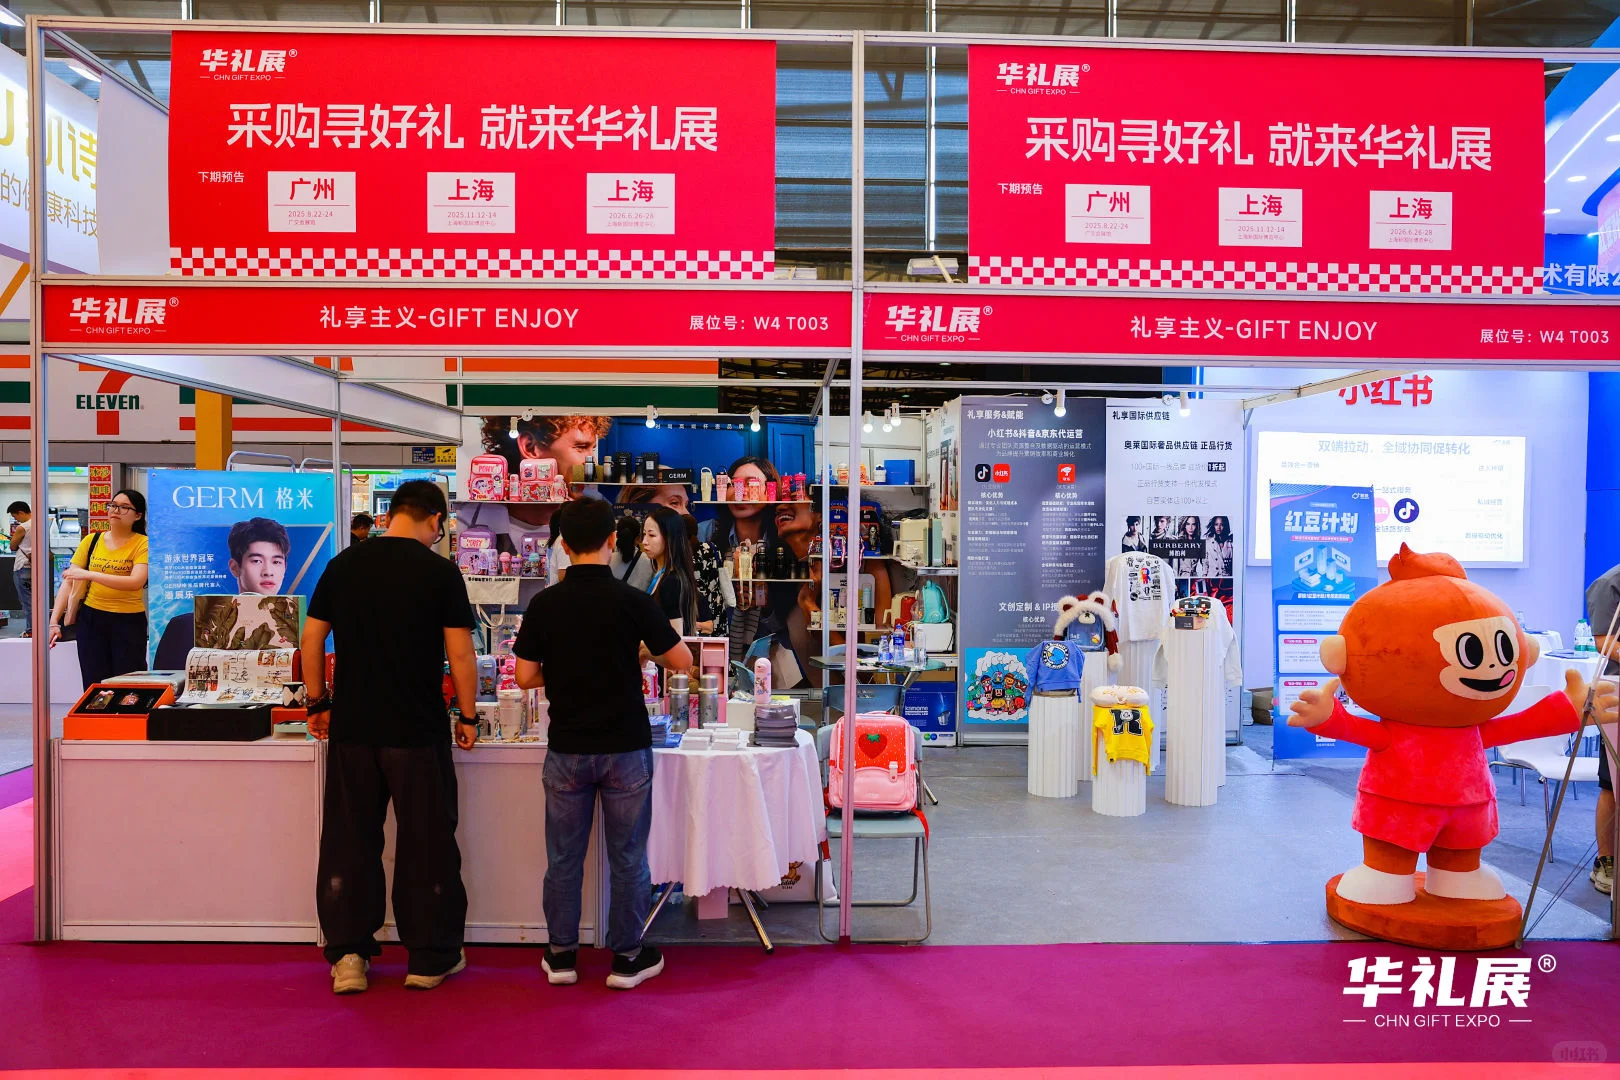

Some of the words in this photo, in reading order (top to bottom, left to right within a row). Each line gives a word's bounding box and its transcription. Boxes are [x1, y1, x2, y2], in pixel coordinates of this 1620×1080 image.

[200, 49, 286, 72] 华礼展
[997, 62, 1080, 87] 华礼展
[227, 102, 465, 149] 采购寻好礼
[480, 104, 718, 152] 就来华礼展
[1025, 117, 1254, 165] 采购寻好礼
[1268, 121, 1492, 171] 就来华礼展
[198, 171, 245, 183] 下期预告
[289, 177, 335, 200] 广州
[447, 178, 495, 202] 上海
[607, 179, 655, 202] 上海
[997, 183, 1043, 195] 下期预告
[0, 168, 98, 238] 的康科技
[1086, 190, 1130, 213] 广州
[1238, 194, 1283, 217] 上海
[1389, 197, 1433, 220] 上海
[447, 211, 497, 219] 2025.11.12-14
[1085, 222, 1129, 230] 2025.8.22-24
[1237, 225, 1285, 233] 2025.11.12-14
[1389, 228, 1433, 236] 2026.6.26-28
[69, 296, 167, 325] 华礼展
[319, 305, 486, 329] 礼享主义-GIFT
[495, 307, 579, 329] ENJOY
[885, 305, 981, 333] 华礼展
[86, 326, 105, 334] CHN
[106, 327, 125, 335] GIFT
[127, 327, 151, 335] EXPO
[753, 316, 780, 330] W4
[786, 316, 829, 331] T003
[1130, 315, 1290, 340] 礼享主义-GIFT
[1299, 320, 1378, 341] ENJOY
[900, 334, 919, 342] CHN
[920, 334, 940, 342] GIFT
[941, 335, 965, 343] EXPO
[1539, 330, 1564, 344] W4
[1570, 330, 1609, 344] T003
[1112, 411, 1170, 420] 礼享国际供应链
[987, 428, 1083, 439] 小红书&抖音&京东代运营
[1200, 441, 1233, 450] 正品行货
[172, 485, 264, 509] GERM
[275, 486, 314, 510] 格米
[1284, 510, 1359, 534] 红豆计划
[999, 602, 1033, 612] 文创定制
